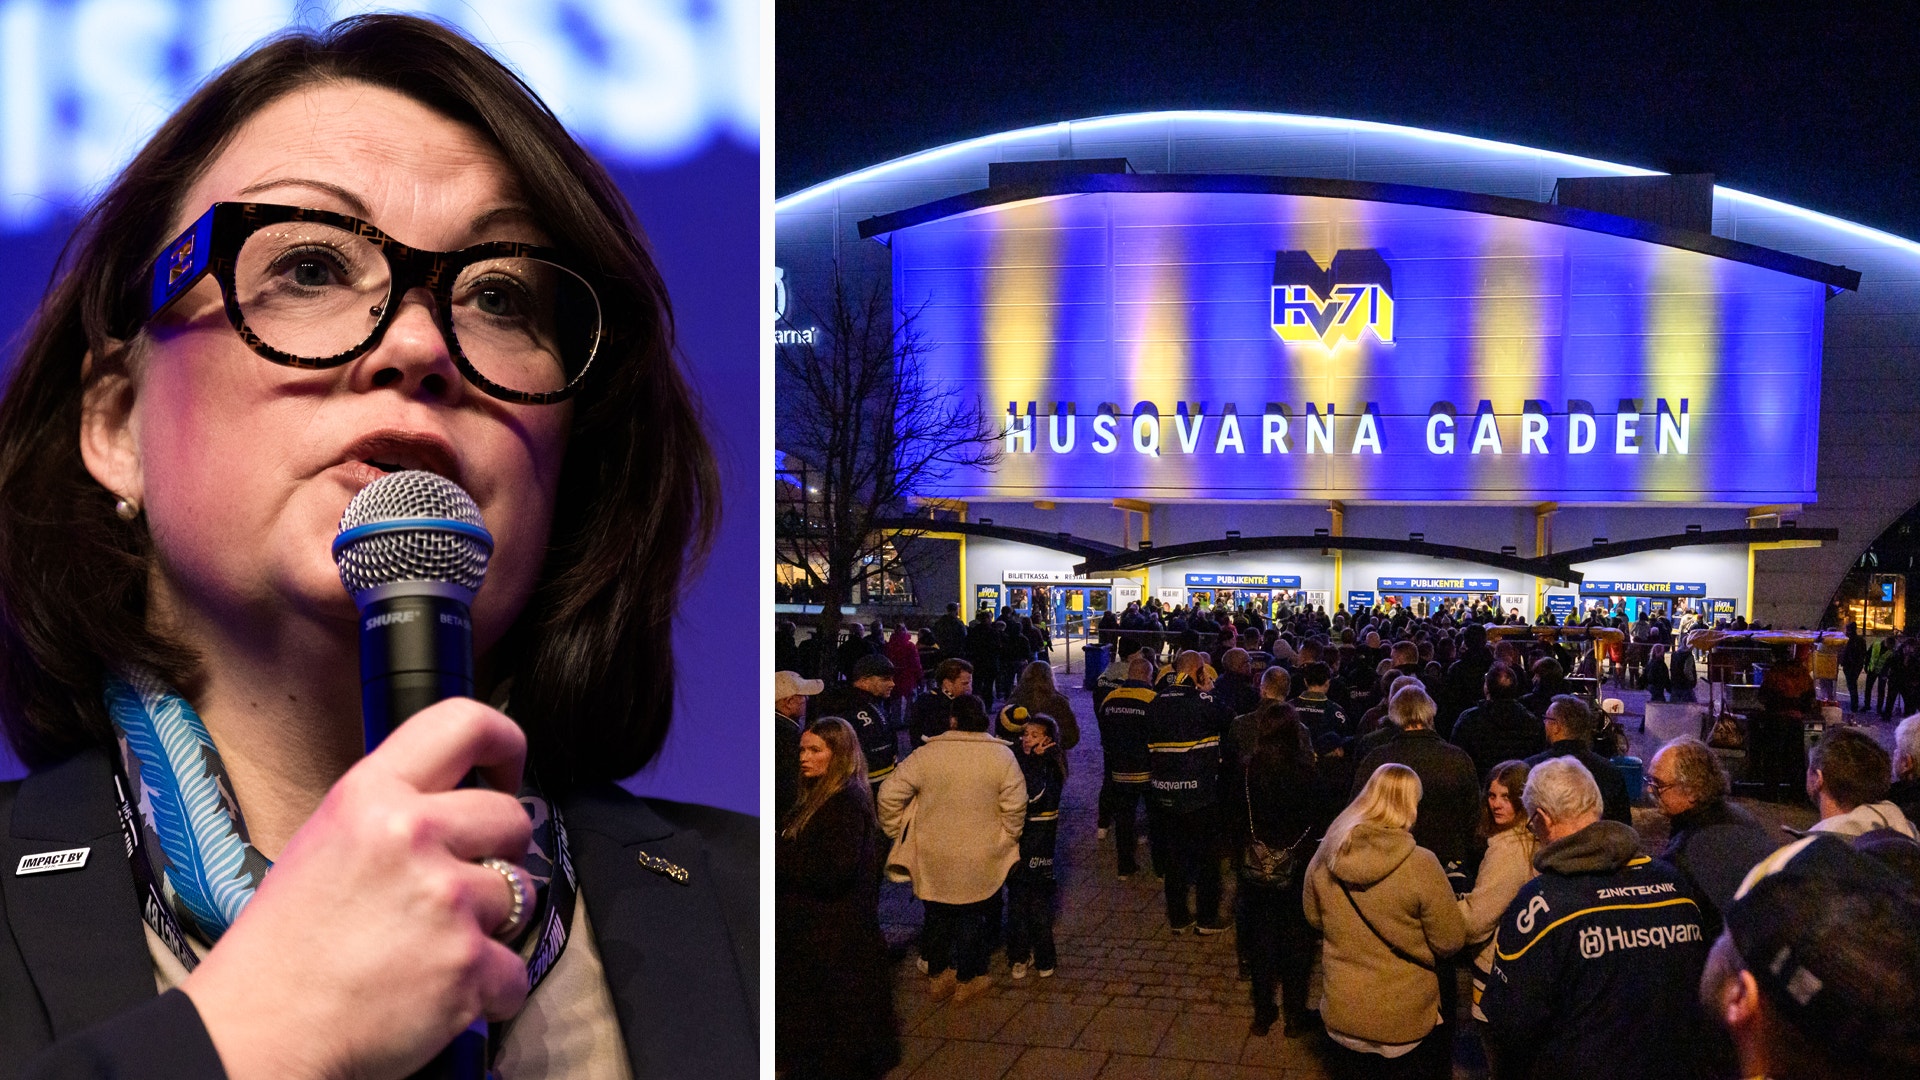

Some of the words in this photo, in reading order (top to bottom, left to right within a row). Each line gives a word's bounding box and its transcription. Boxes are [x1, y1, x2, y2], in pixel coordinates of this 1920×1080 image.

[1271, 284, 1393, 345] HV71
[1005, 412, 1383, 457] HUSQVARNA
[1426, 411, 1690, 455] GARDEN
[1216, 574, 1269, 585] PUBLIKENTRÉ
[1410, 578, 1465, 588] PUBLIKENTRÉ
[1614, 582, 1671, 592] PUBLIKENTRÉ
[365, 610, 415, 631] SHURE
[21, 853, 68, 868] IMPACT
[67, 851, 84, 862] BY
[1596, 882, 1677, 899] ZINKTEKNIK
[1605, 923, 1703, 951] Husqvarn
